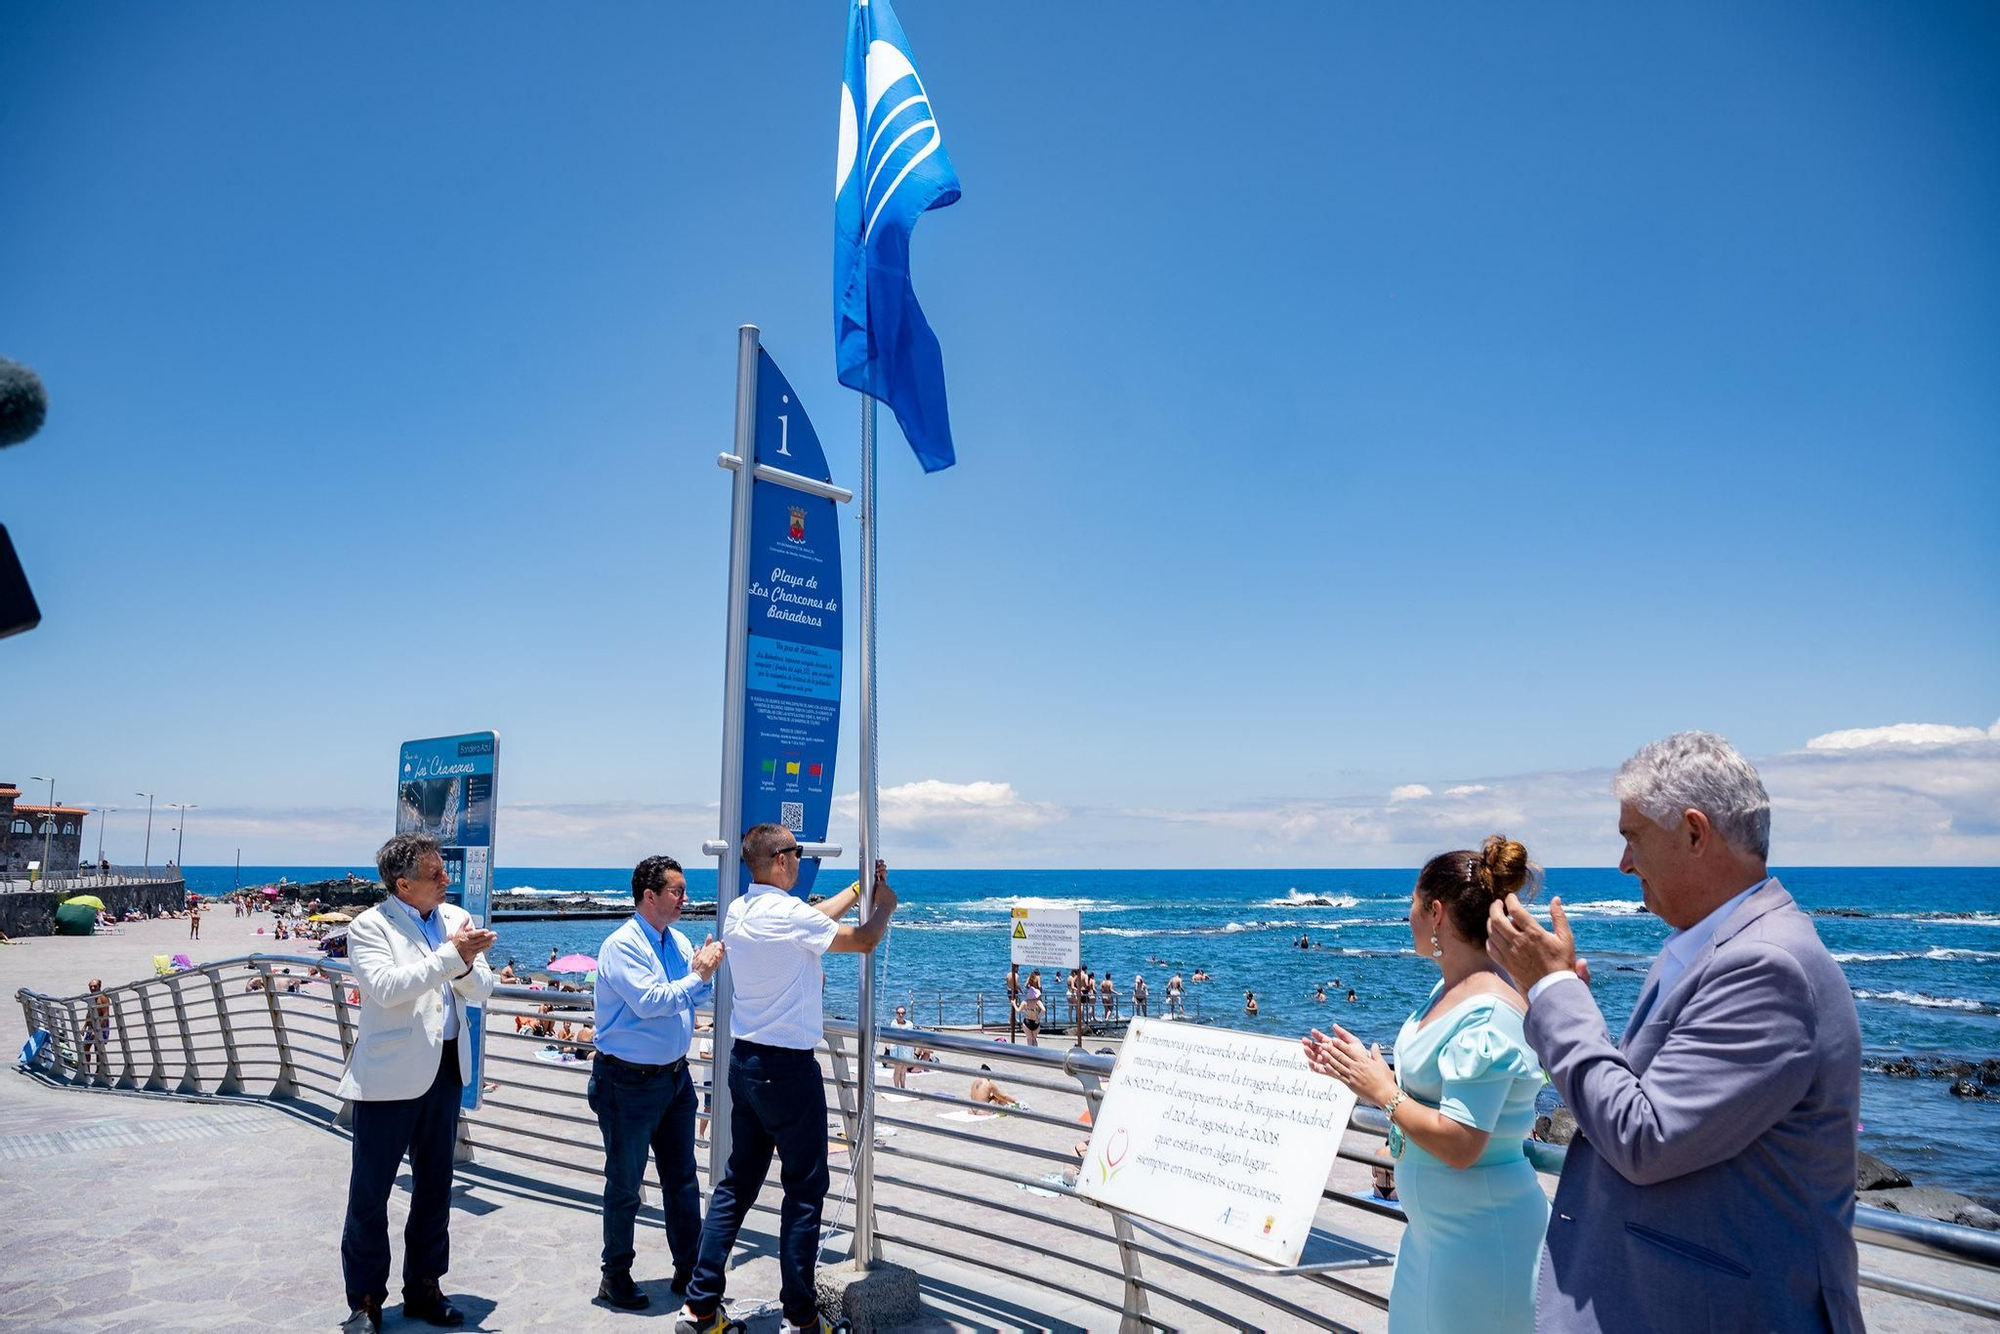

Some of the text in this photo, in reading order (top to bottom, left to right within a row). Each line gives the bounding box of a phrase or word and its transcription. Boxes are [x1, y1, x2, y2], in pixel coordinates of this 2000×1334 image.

[776, 394, 792, 457] i
[770, 567, 819, 589] Playa de
[749, 582, 838, 612] Los Charcones de
[767, 604, 822, 627] Bañaderos
[460, 742, 492, 754] Bandera Azul
[414, 757, 427, 779] Los
[1149, 1036, 1185, 1051] memoria
[1184, 1043, 1193, 1057] y
[1193, 1043, 1236, 1059] recuerdo
[1236, 1045, 1251, 1061] de
[1252, 1047, 1267, 1064] las
[1268, 1050, 1309, 1071] familias
[1133, 1056, 1338, 1102] municipio fallecidas en la tragedia del vuelo
[1153, 1084, 1165, 1093] en
[1165, 1081, 1177, 1096] el
[1175, 1087, 1229, 1108] aeropuerto
[1229, 1093, 1243, 1110] de
[1162, 1104, 1174, 1120] el
[1172, 1109, 1186, 1123] 20
[1185, 1109, 1199, 1126] de
[1199, 1119, 1234, 1135] agosto
[1234, 1121, 1249, 1138] de
[1154, 1134, 1172, 1151] que
[1173, 1139, 1199, 1153] están
[1199, 1146, 1212, 1156] en
[1213, 1143, 1242, 1167] algún
[1136, 1154, 1170, 1175] siempre
[1170, 1164, 1183, 1176] en
[1183, 1168, 1226, 1187] nuestros
